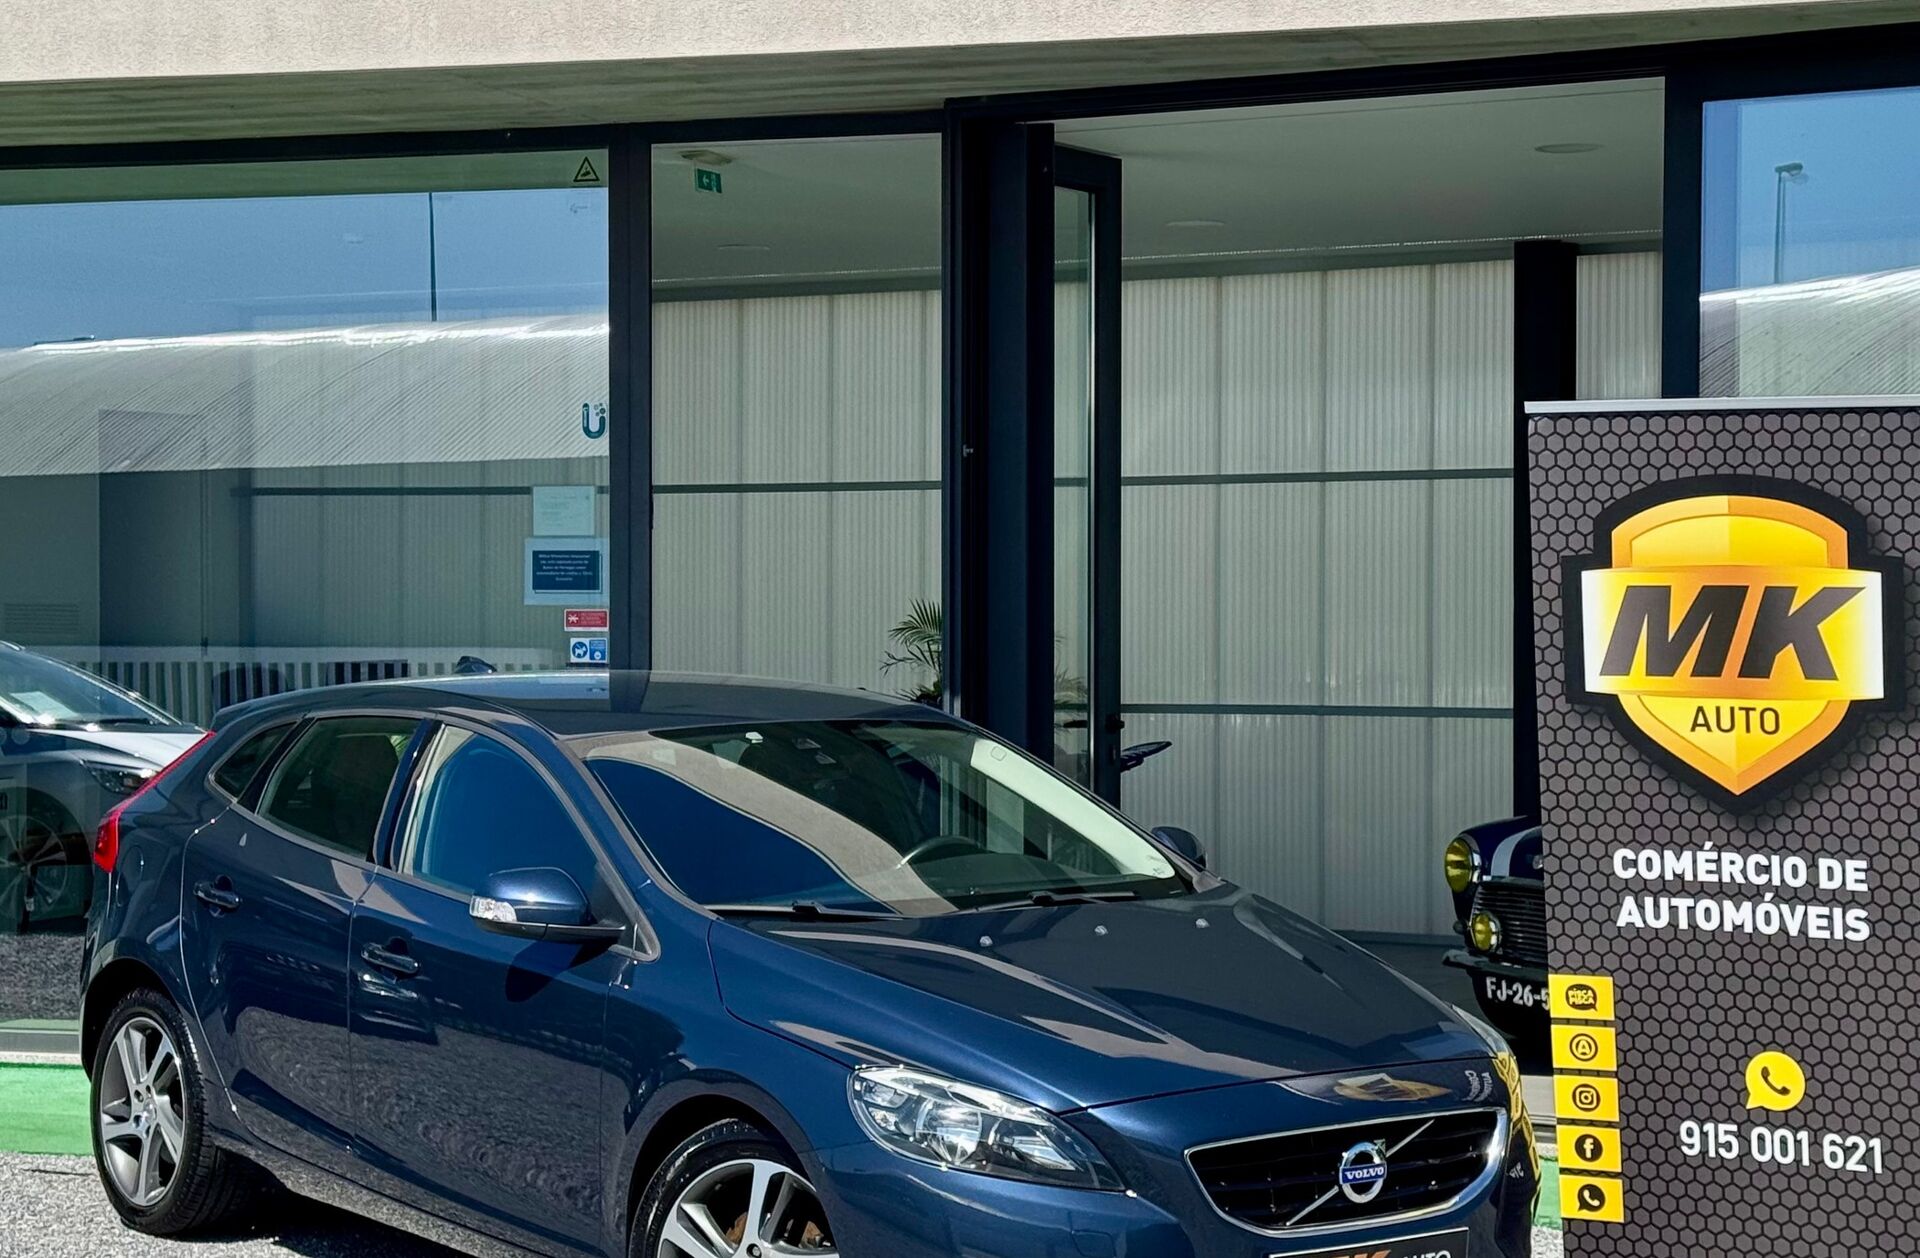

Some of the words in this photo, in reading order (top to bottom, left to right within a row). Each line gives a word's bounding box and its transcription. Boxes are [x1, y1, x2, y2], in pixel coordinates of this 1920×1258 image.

[1599, 585, 1867, 681] MK
[1690, 706, 1781, 735] AUTO
[1612, 841, 1808, 888] COMÉRCIO
[1817, 857, 1869, 892] DE
[1616, 892, 1870, 942] AUTOMÓVEIS
[1679, 1120, 1739, 1160] 915
[1750, 1126, 1810, 1166] 001
[1822, 1133, 1883, 1174] 621
[1344, 1166, 1385, 1180] VOLVO
